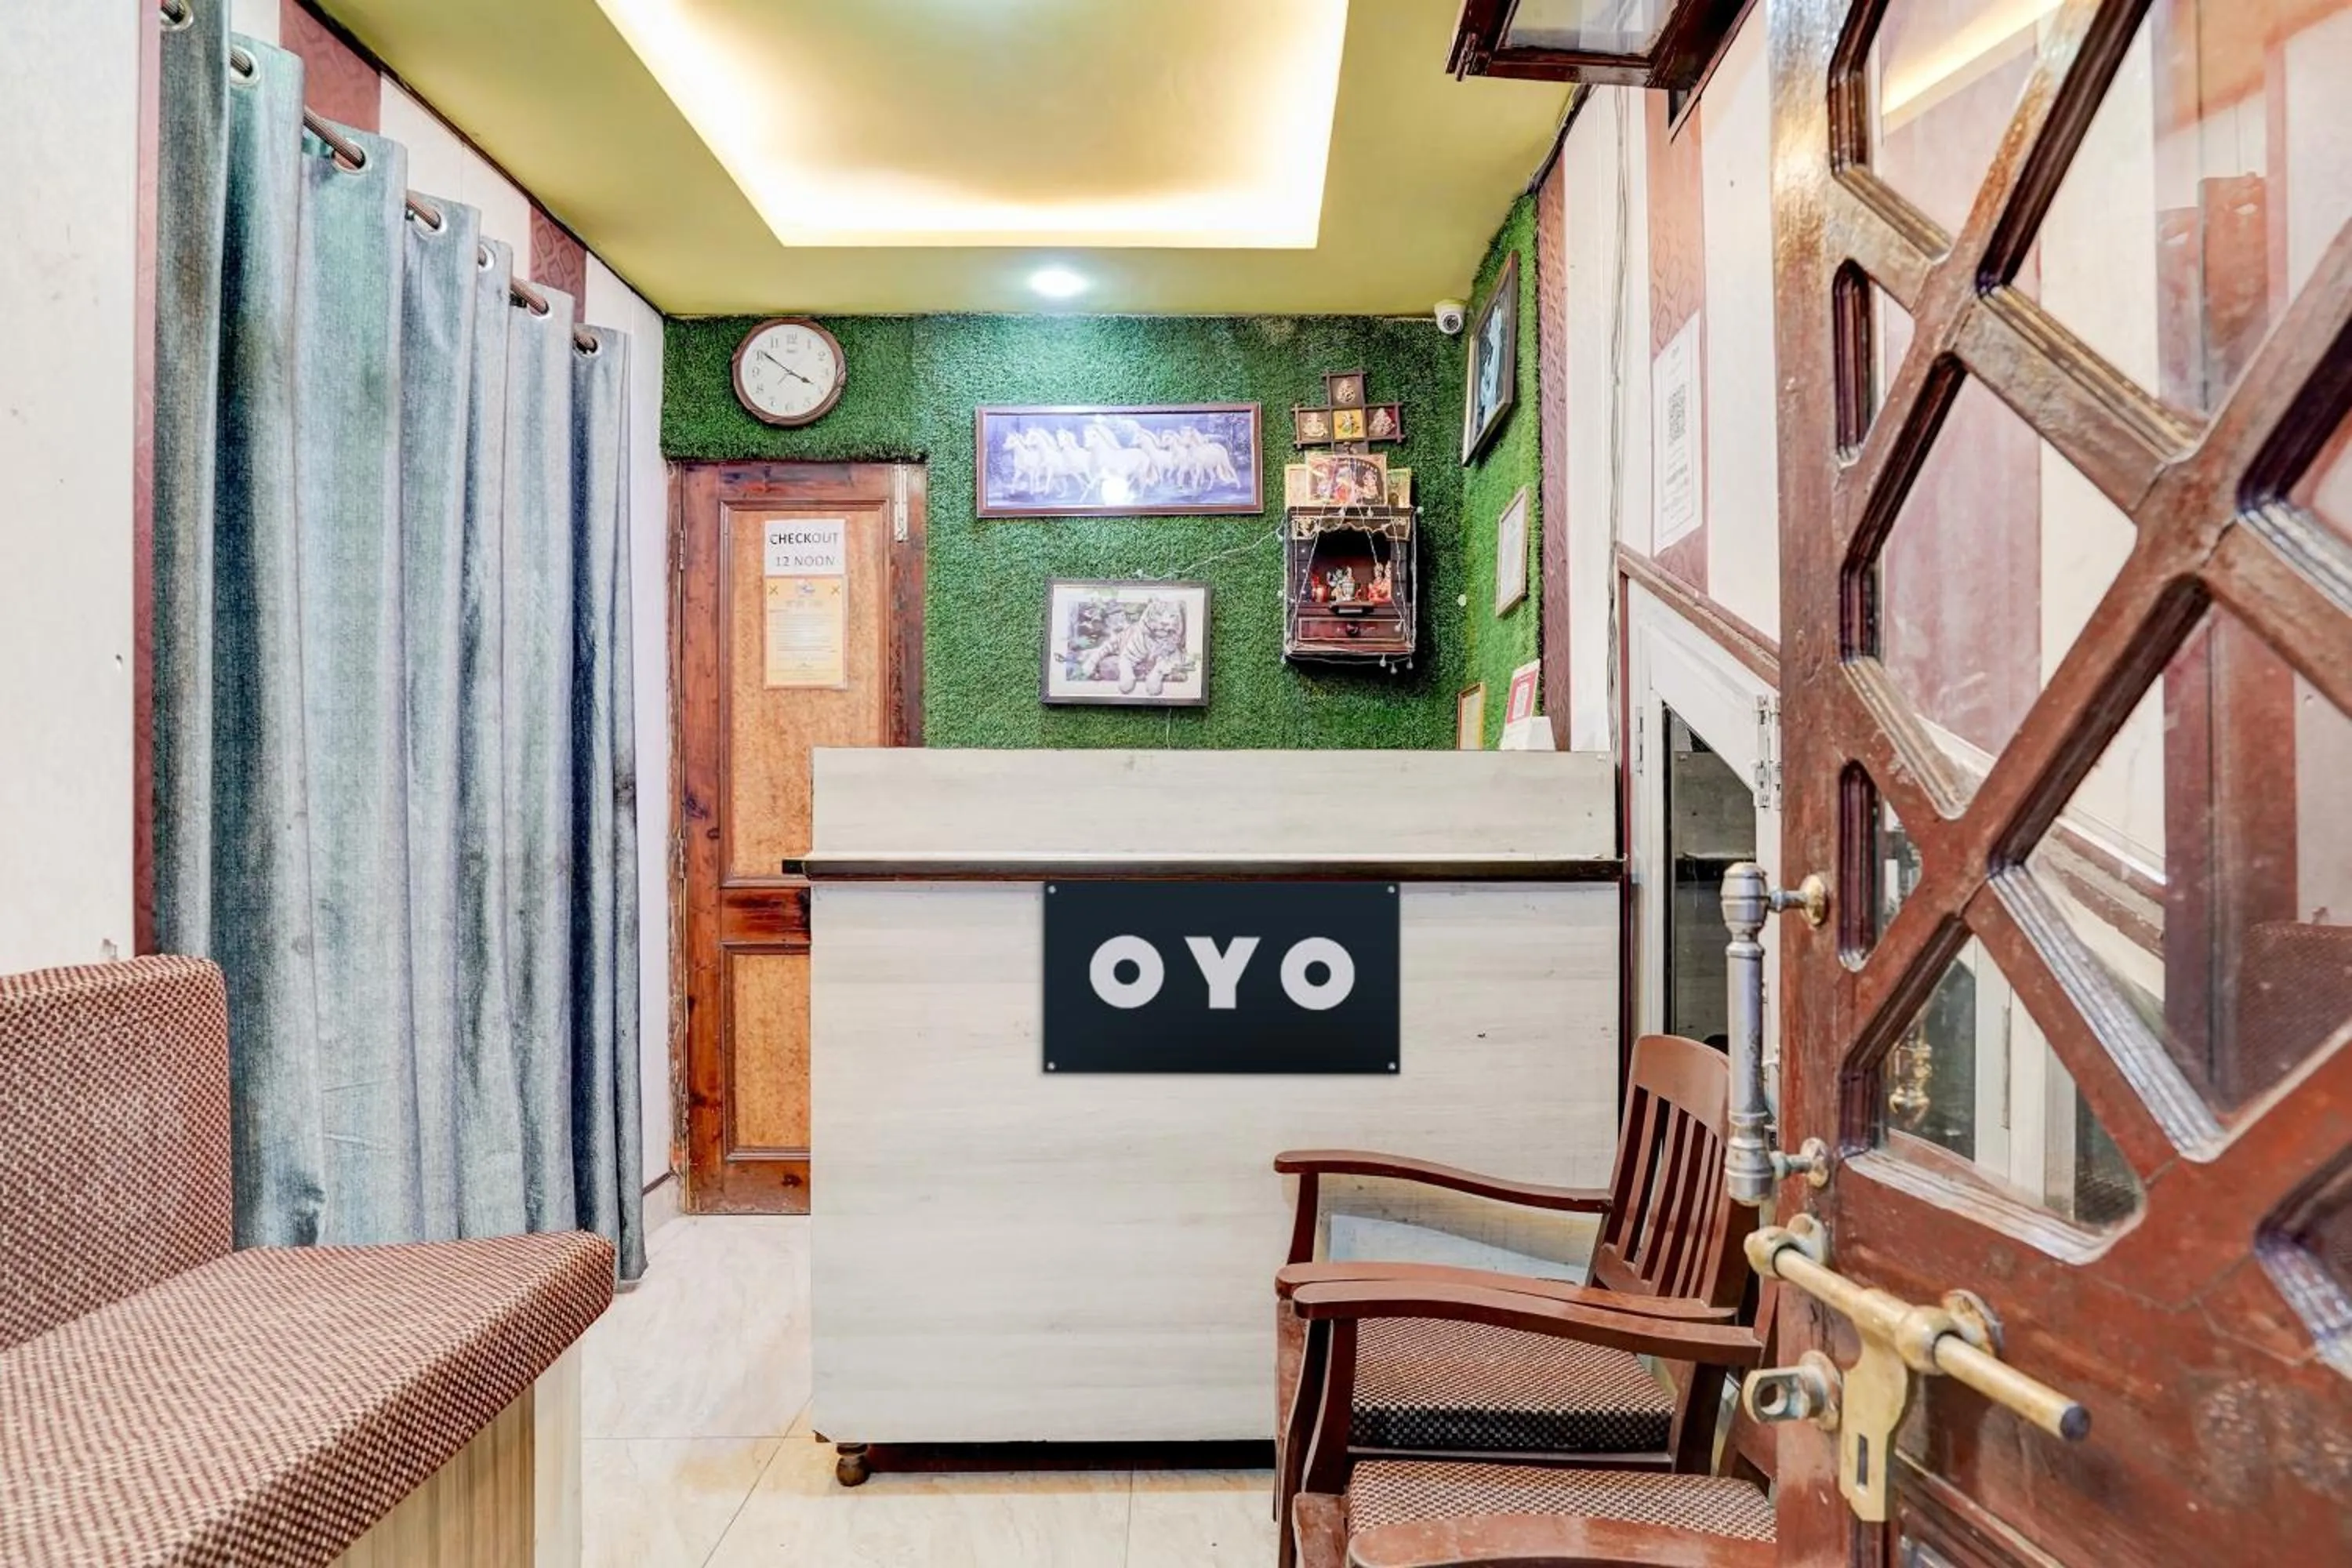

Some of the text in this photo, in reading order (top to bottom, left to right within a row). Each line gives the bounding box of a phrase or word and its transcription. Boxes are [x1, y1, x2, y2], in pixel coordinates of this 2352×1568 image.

[770, 532, 838, 545] CHECKOUT
[776, 556, 836, 567] 12 NOON
[1089, 935, 1356, 1011] OYO
